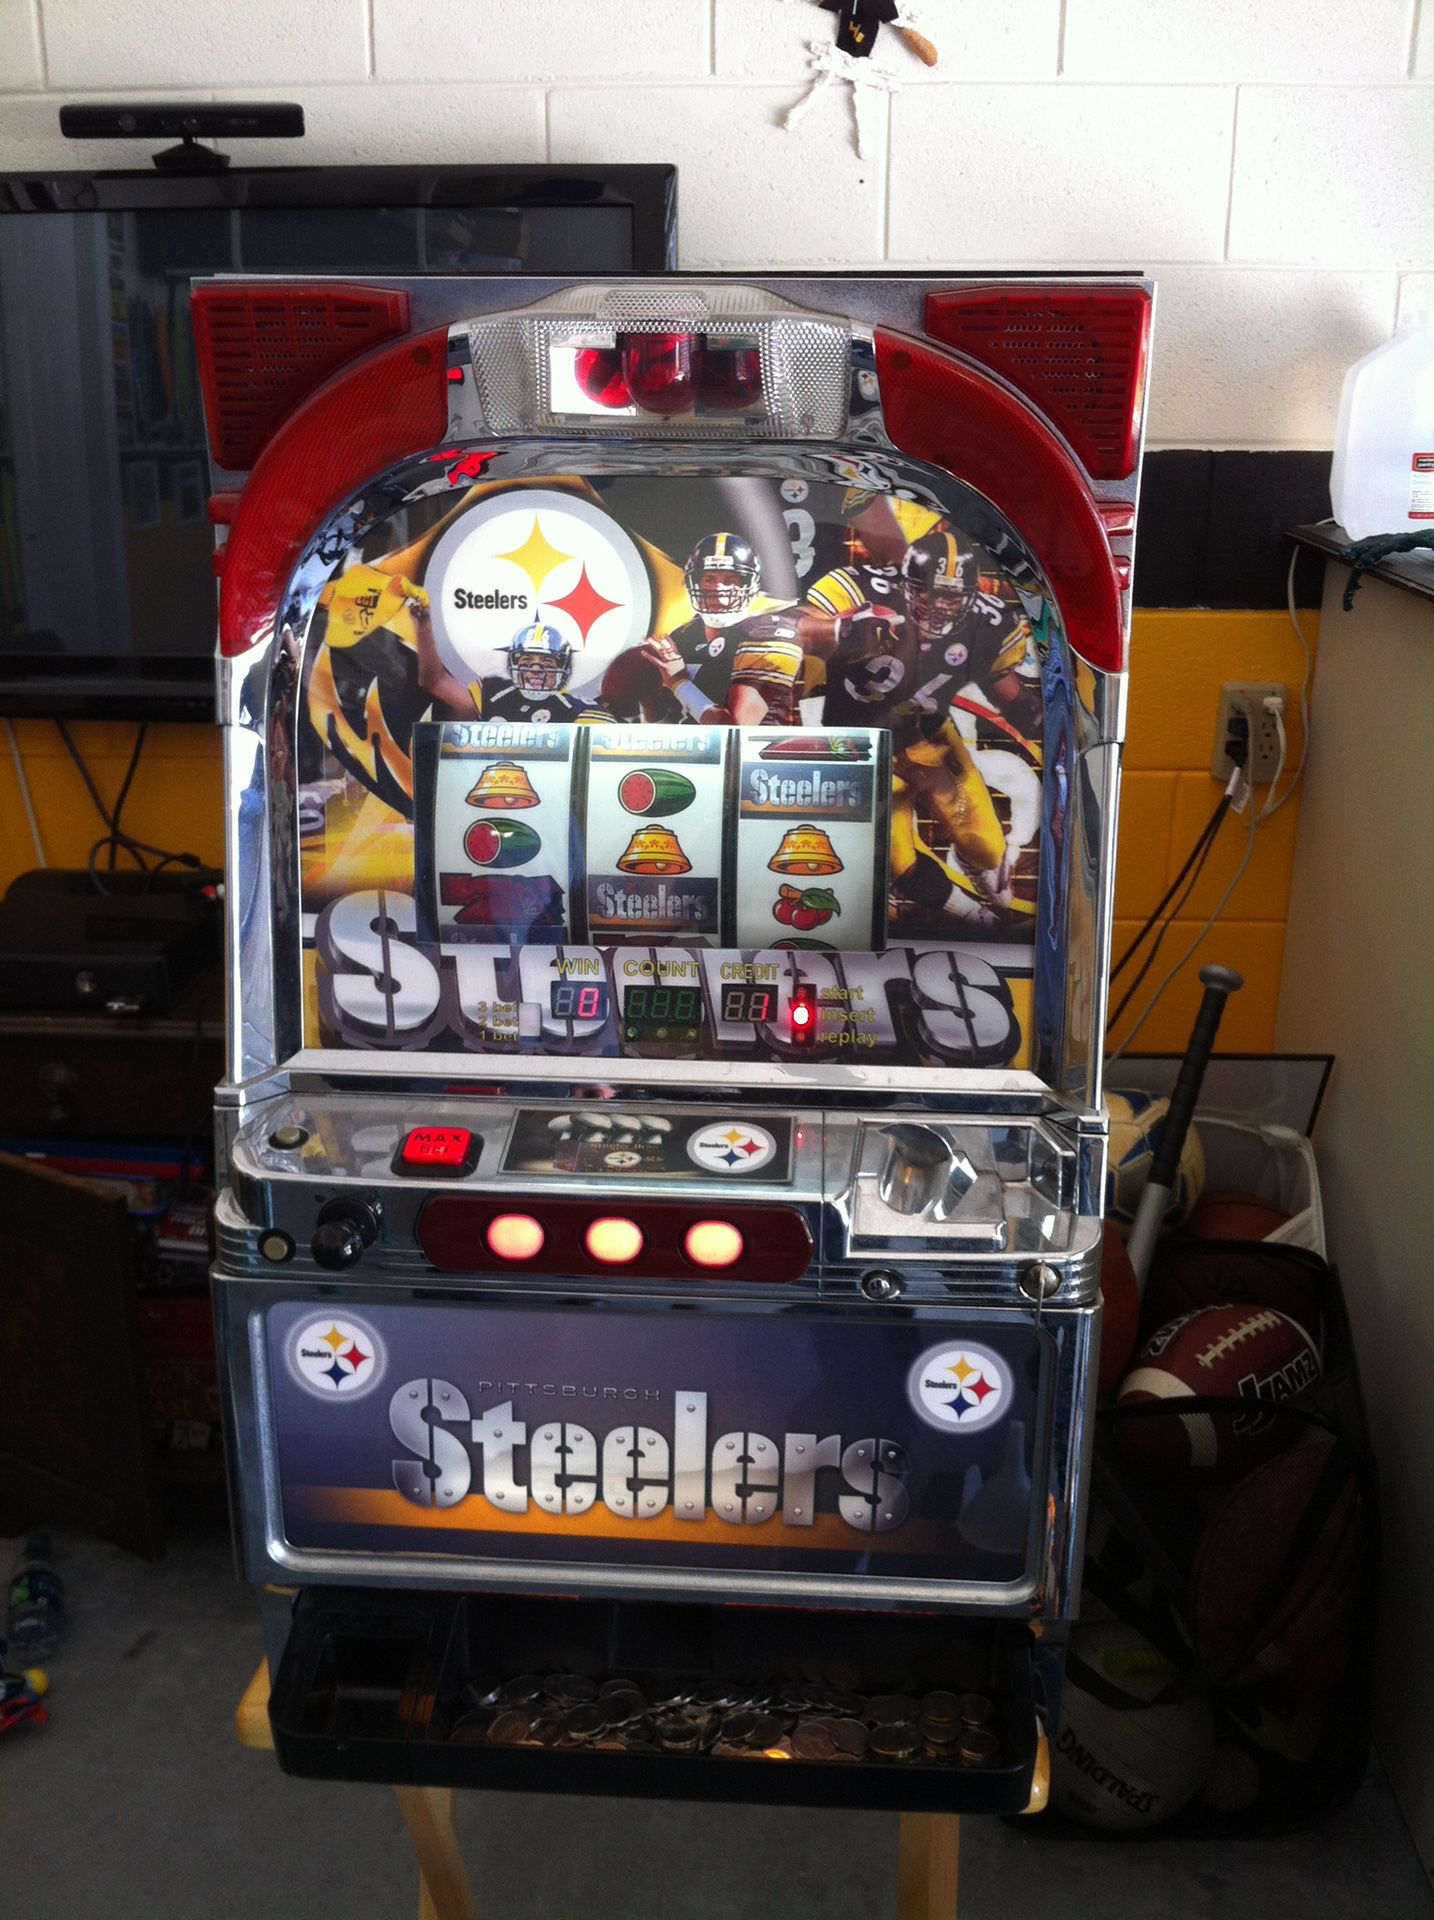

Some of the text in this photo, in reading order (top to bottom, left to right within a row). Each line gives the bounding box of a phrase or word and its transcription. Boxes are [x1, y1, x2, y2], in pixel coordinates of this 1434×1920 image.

[454, 587, 529, 610] Steelers
[749, 768, 864, 808] Steelers
[597, 881, 708, 920] Steelers
[556, 958, 600, 976] WIN
[623, 959, 700, 978] COUNT
[719, 962, 780, 981] CREDIT
[820, 984, 865, 1001] start
[478, 1001, 518, 1013] 3 bet
[821, 1007, 876, 1023] insert
[478, 1016, 520, 1028] 2 bet
[480, 1030, 520, 1041] 1 bet
[820, 1028, 878, 1048] replay
[413, 1132, 463, 1143] MAX
[699, 1140, 730, 1150] Steelers
[301, 1347, 332, 1359] Steelers
[478, 1380, 661, 1401] PITTSBURGH
[924, 1378, 958, 1390] Steelers
[389, 1377, 911, 1533] Steelers
